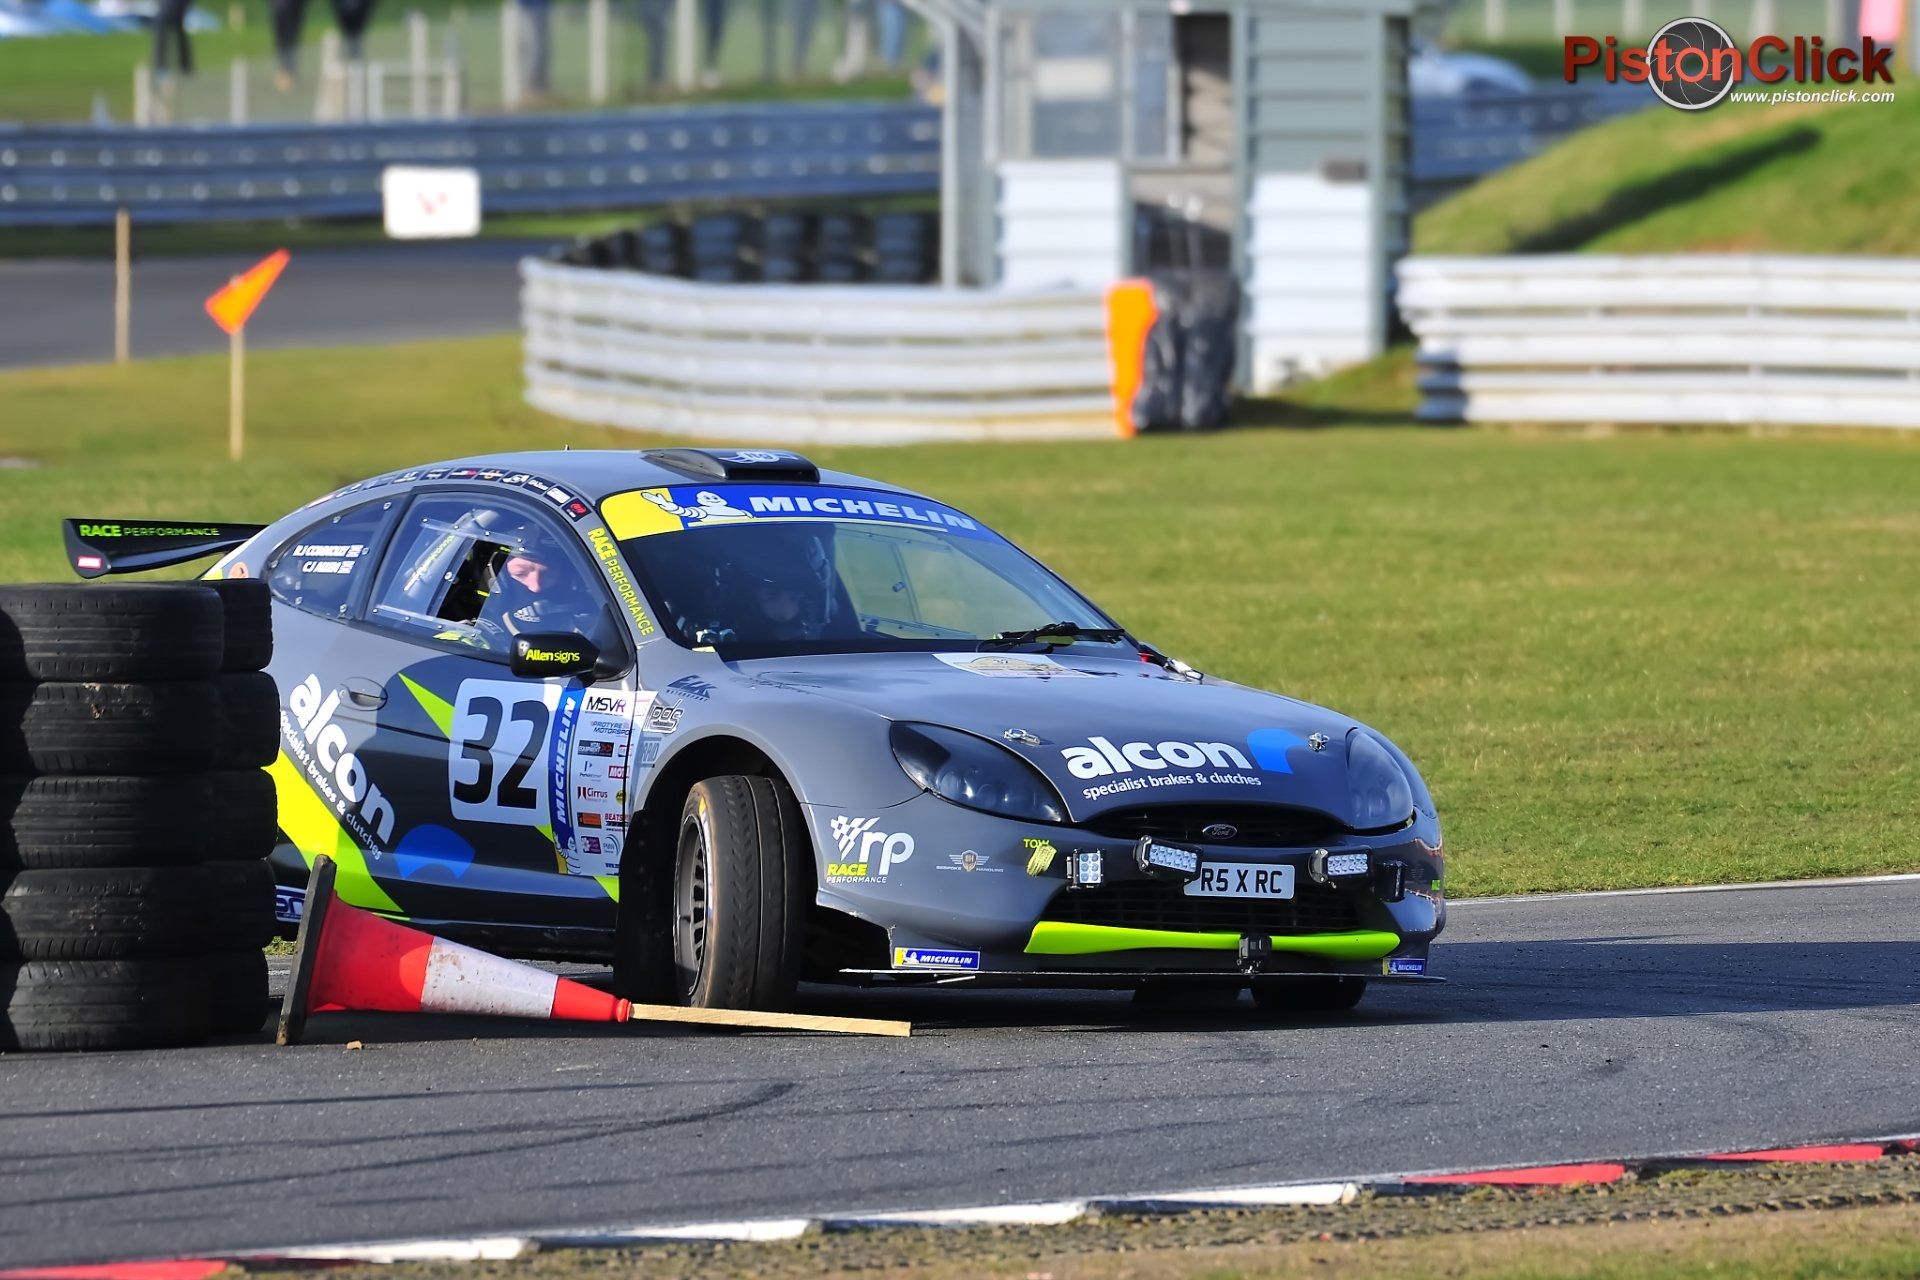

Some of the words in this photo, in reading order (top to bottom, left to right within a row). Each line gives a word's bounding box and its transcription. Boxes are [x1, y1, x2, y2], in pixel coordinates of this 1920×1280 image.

[749, 495, 977, 531] MICHELIN
[79, 525, 122, 536] RACE
[124, 527, 220, 536] PERFORMANCE
[587, 527, 616, 561] RACE
[604, 559, 655, 636] PERFORMANCE
[586, 696, 626, 713] MSVR
[289, 673, 395, 844] alcon
[453, 696, 550, 810] 32
[556, 696, 576, 824] MICHELIN
[1060, 736, 1253, 780] alcon
[587, 787, 608, 798] Cirrus
[1083, 777, 1148, 801] specialist
[1150, 772, 1194, 788] brakes
[1197, 773, 1208, 785] &
[1210, 772, 1262, 787] clutches
[307, 759, 338, 804] brakes
[336, 800, 346, 816] &
[346, 812, 383, 861] clutches
[1211, 826, 1231, 836] Ford
[1023, 838, 1050, 849] TOW
[826, 863, 868, 876] RACE
[826, 876, 888, 884] PERFORMANCE
[1201, 867, 1228, 893] R5
[1236, 869, 1248, 894] X
[1254, 869, 1282, 895] RC
[919, 955, 973, 965] MICHELIN
[1397, 963, 1423, 971] MICHELIN
